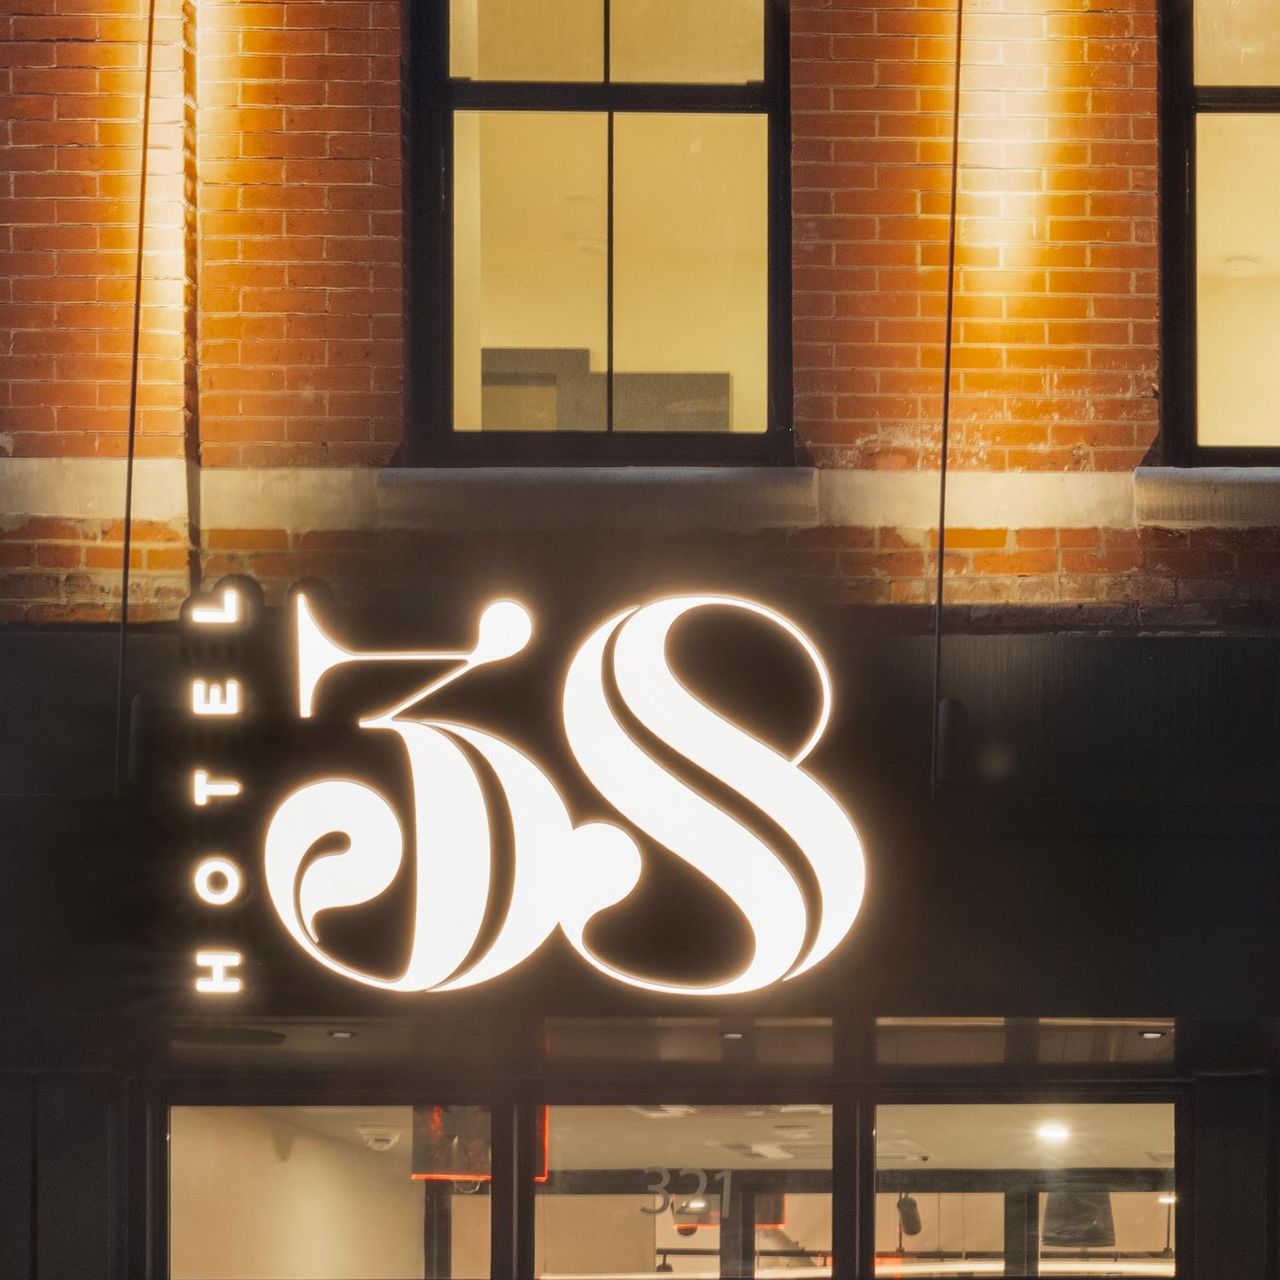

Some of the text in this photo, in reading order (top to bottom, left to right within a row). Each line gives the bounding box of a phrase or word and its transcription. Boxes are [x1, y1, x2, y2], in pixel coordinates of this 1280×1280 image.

[191, 590, 242, 993] HOTEL
[264, 593, 867, 996] 38
[640, 1167, 732, 1218] 321
